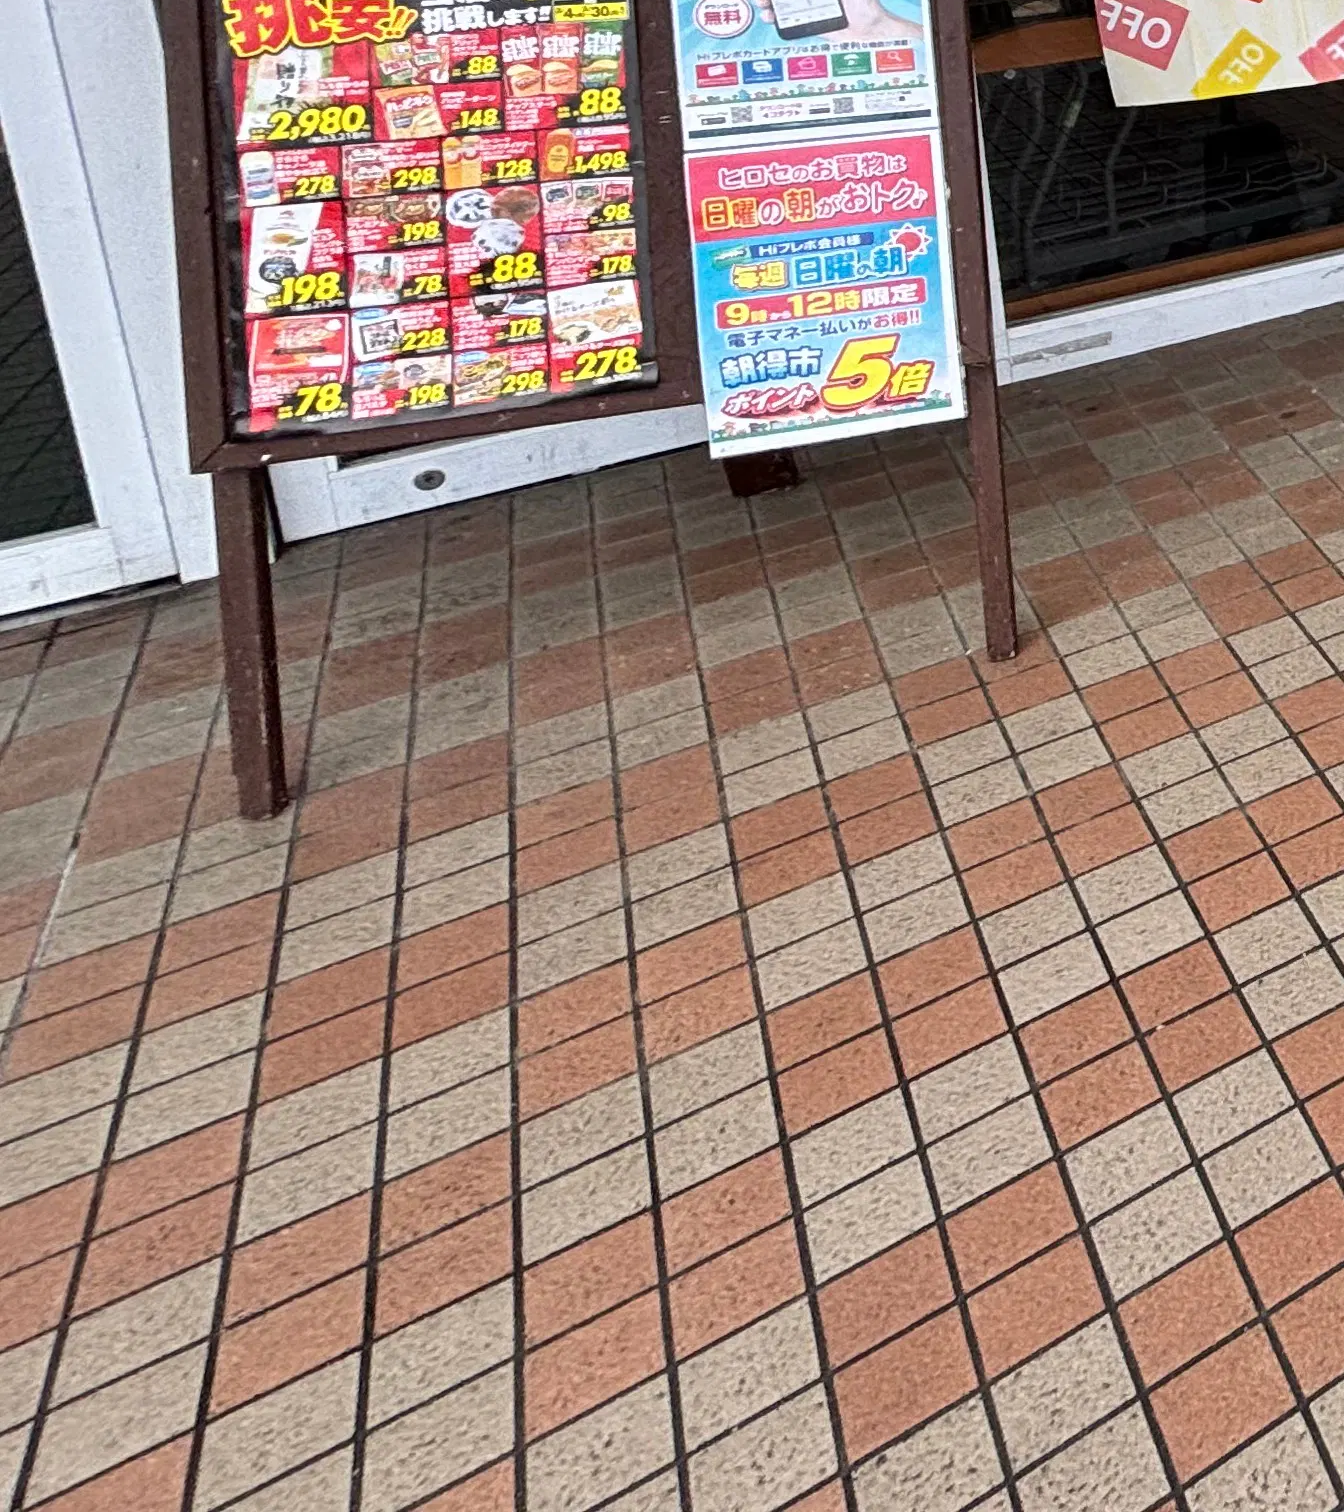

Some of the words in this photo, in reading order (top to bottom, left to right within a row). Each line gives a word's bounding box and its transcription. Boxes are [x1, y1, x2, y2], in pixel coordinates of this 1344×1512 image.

[421, 4, 550, 35] 挑戦します!!
[703, 9, 742, 26] 無料
[467, 55, 498, 74] 88
[579, 86, 622, 116] 88
[267, 104, 367, 141] 2,980
[460, 108, 499, 128] 148
[495, 158, 533, 179] 128
[573, 150, 627, 174] 1,498
[718, 151, 908, 190] ヒロセのお買物は
[295, 174, 336, 197] 278
[393, 166, 438, 189] 298
[602, 202, 631, 222] 98
[402, 221, 441, 242] 198
[492, 251, 538, 282] 88
[602, 255, 633, 274] 178
[732, 261, 788, 291] 毎週
[281, 271, 341, 306] 198
[414, 274, 443, 294] 78
[403, 327, 446, 353] 228
[509, 317, 543, 338] 178
[728, 309, 921, 349] 電子マネー払いがお得!!
[573, 345, 638, 382] 278
[719, 345, 823, 389] 朝得市
[820, 332, 936, 410] 5倍
[501, 369, 545, 394] 298
[295, 382, 343, 417] 78
[408, 383, 446, 406] 198
[722, 382, 820, 416] ポイント
